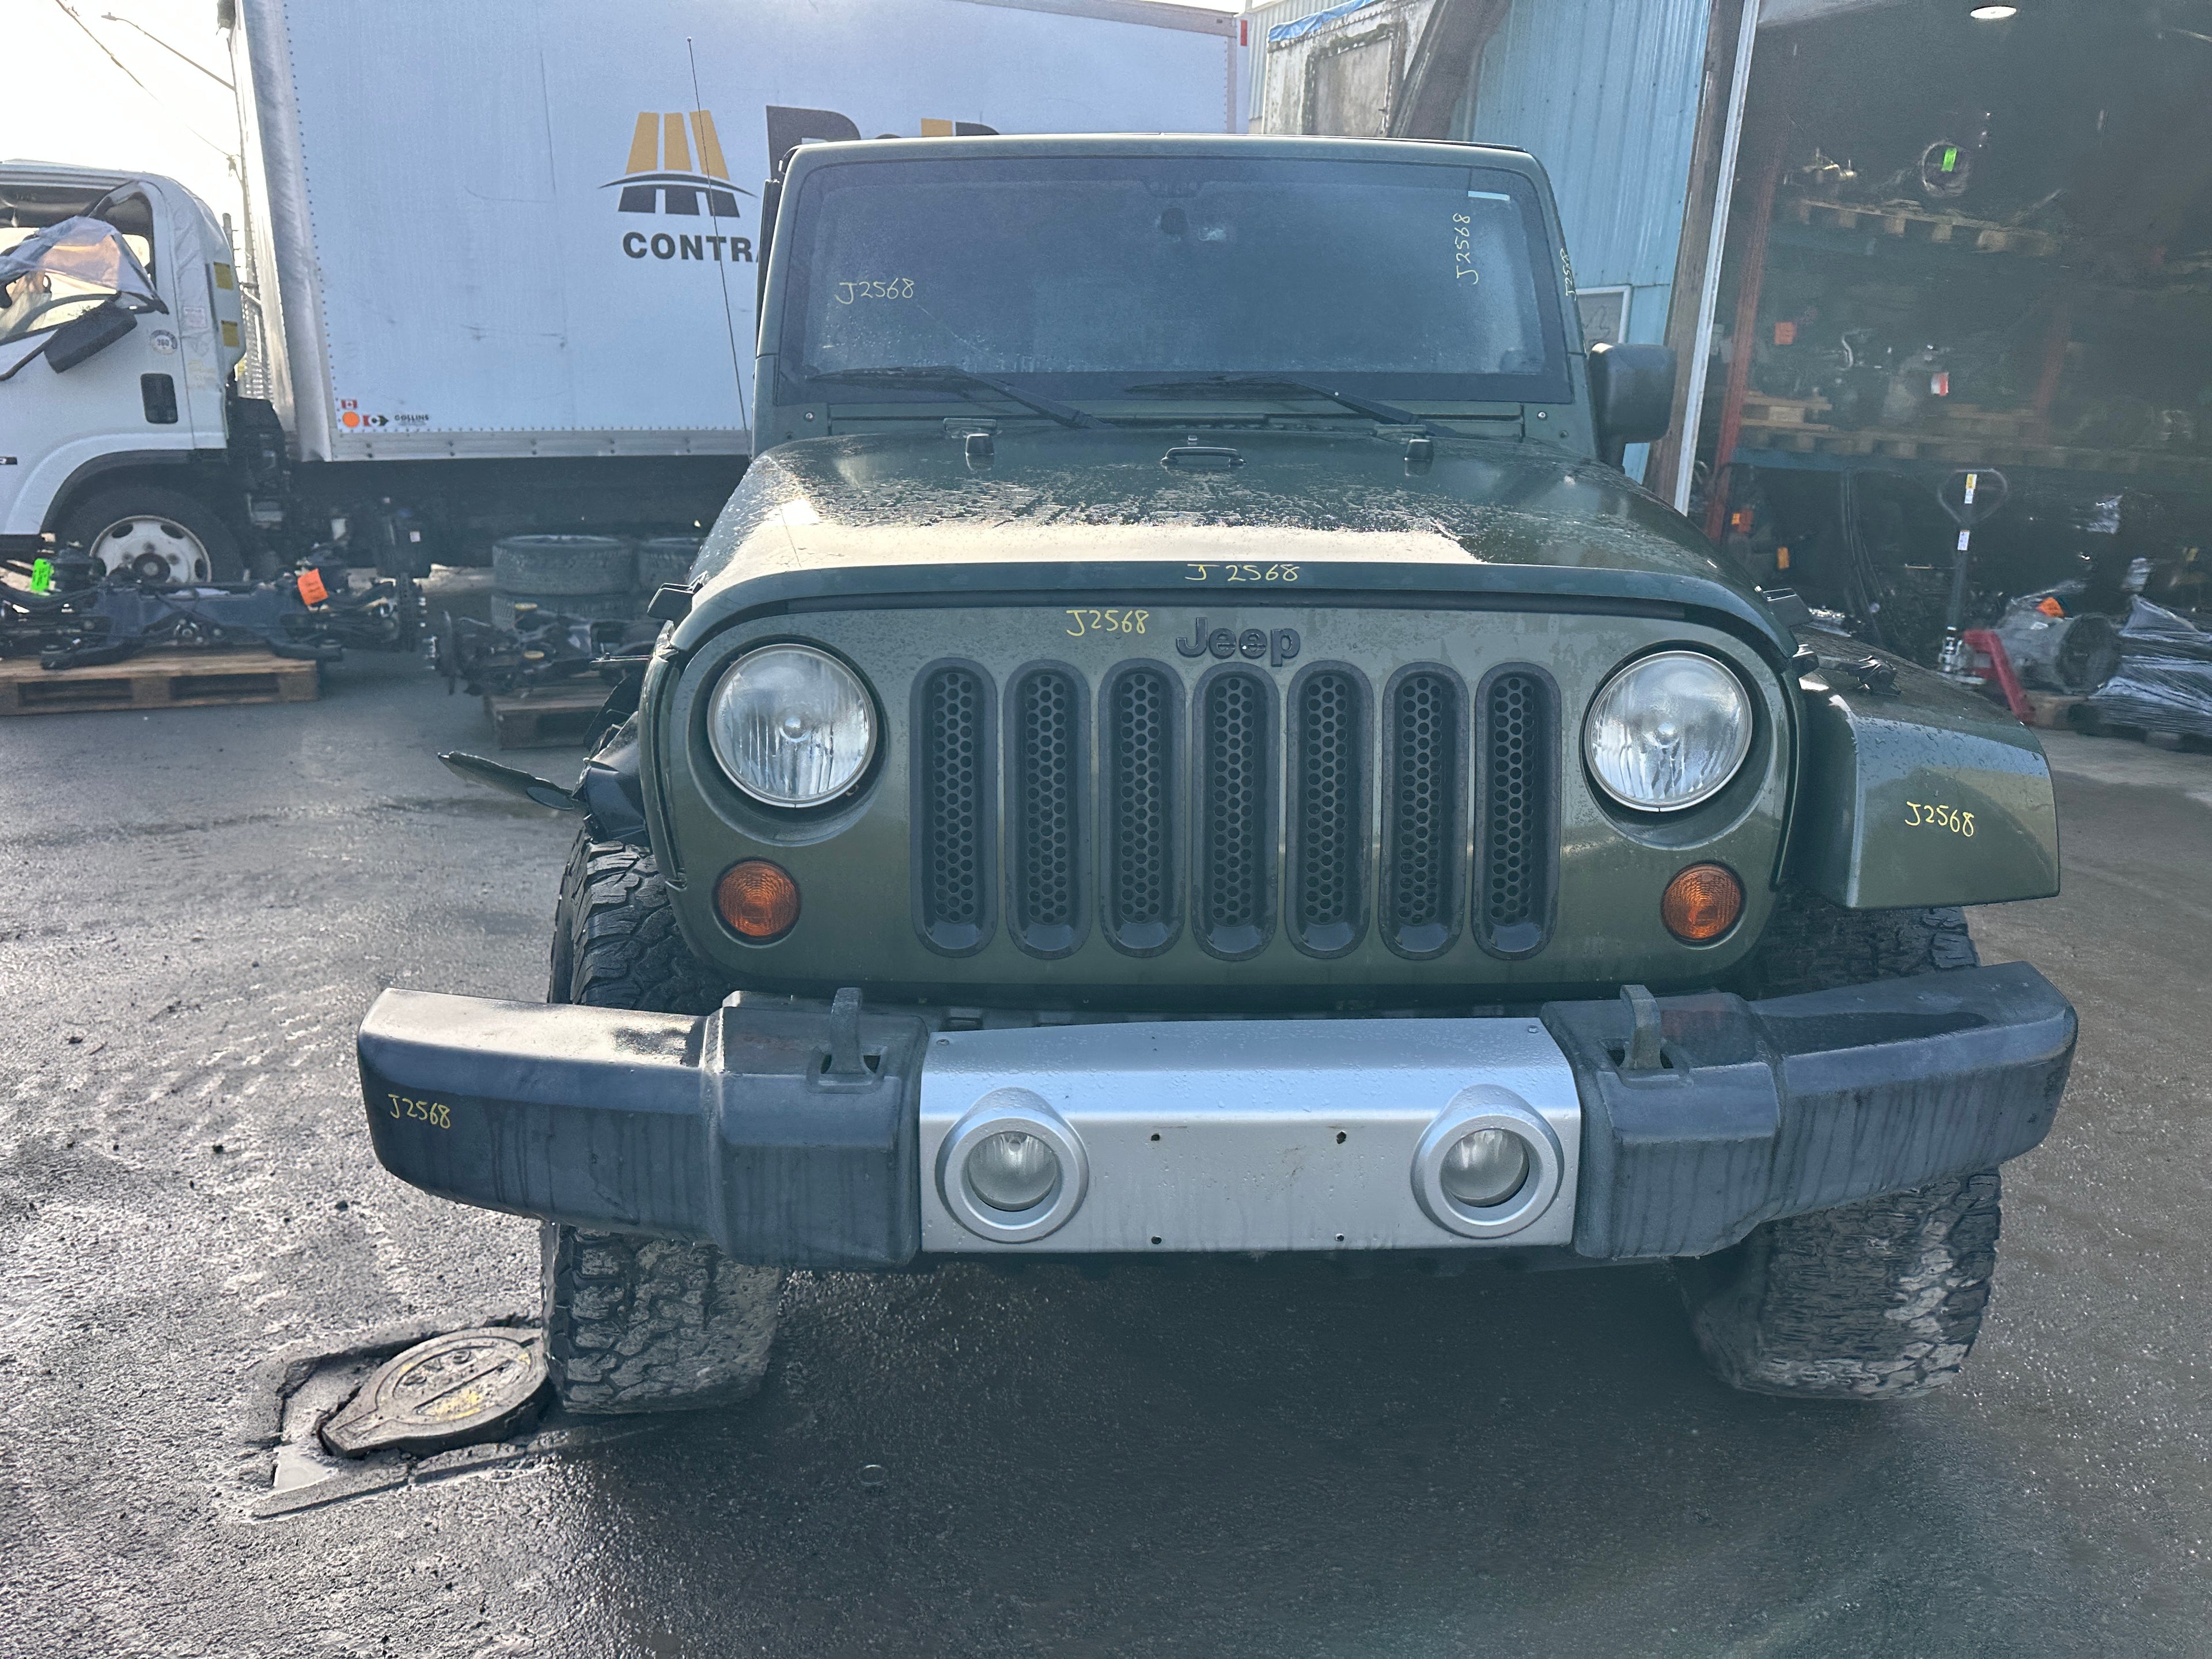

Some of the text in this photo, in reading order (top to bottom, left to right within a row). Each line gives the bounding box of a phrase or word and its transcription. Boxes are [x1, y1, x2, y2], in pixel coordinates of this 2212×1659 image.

[623, 232, 759, 263] CONTR
[1452, 213, 1479, 285] J2568
[834, 277, 915, 305] J2568
[1066, 609, 1149, 637] J2568
[1176, 617, 1301, 667] Jeep
[1904, 801, 1975, 837] J2568
[388, 1093, 451, 1129] J2568
